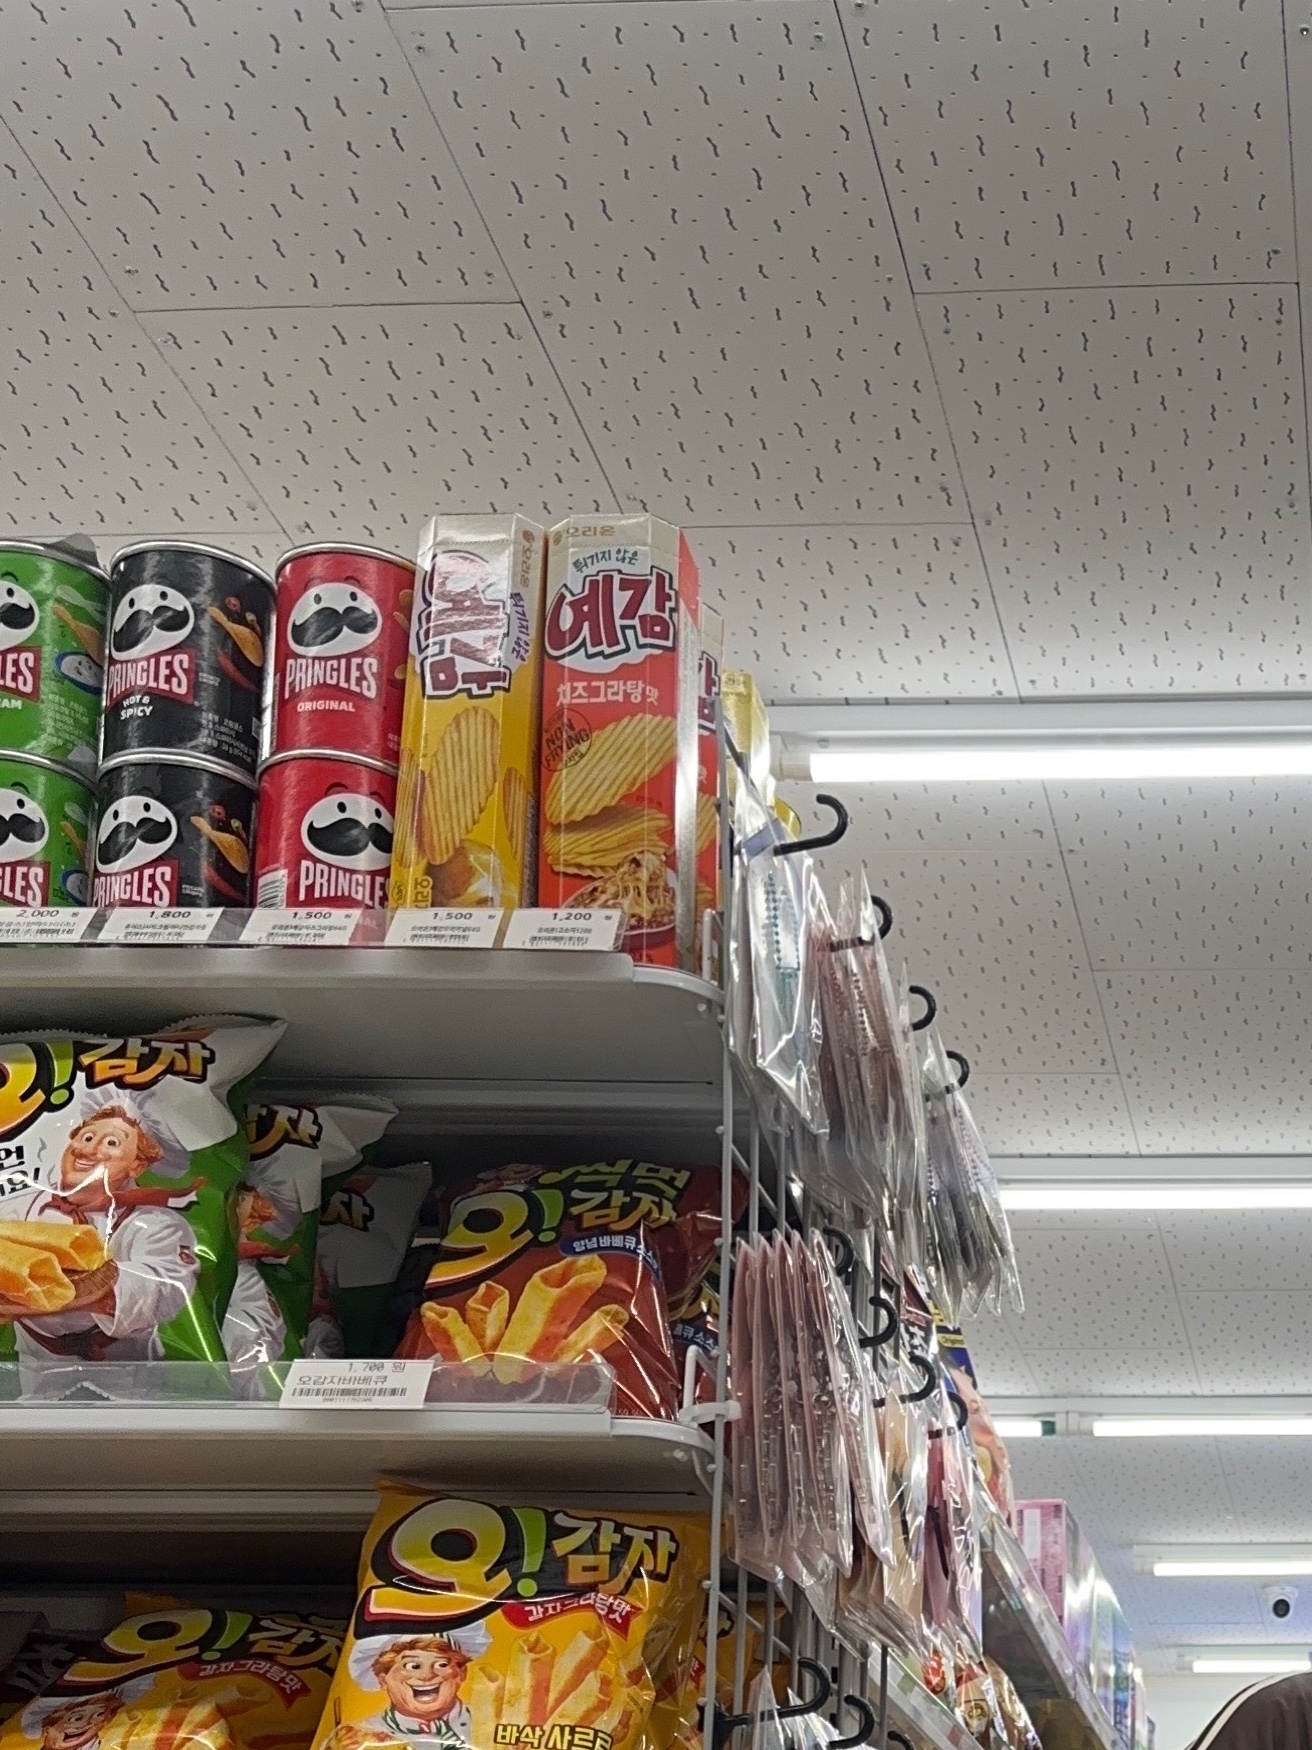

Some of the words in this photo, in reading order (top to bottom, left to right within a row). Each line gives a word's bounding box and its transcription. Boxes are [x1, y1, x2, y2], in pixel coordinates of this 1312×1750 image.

[566, 525, 616, 537] 오리온
[573, 551, 613, 574] 튀기지
[616, 548, 639, 564] 않은
[545, 569, 676, 659] 예감
[107, 652, 189, 697] PRINGLES
[284, 657, 377, 698] PRINGLES
[120, 705, 154, 720] SPICY
[123, 696, 141, 707] HOT
[143, 694, 150, 705] &
[296, 701, 356, 712] ORIGINAL
[93, 867, 174, 909] PRINGLES
[78, 1038, 216, 1088] 감자
[297, 1375, 388, 1386] 오감자바베큐
[362, 1498, 548, 1624] 오!
[551, 1509, 678, 1593] 감자
[495, 1723, 544, 1750] 바삭
